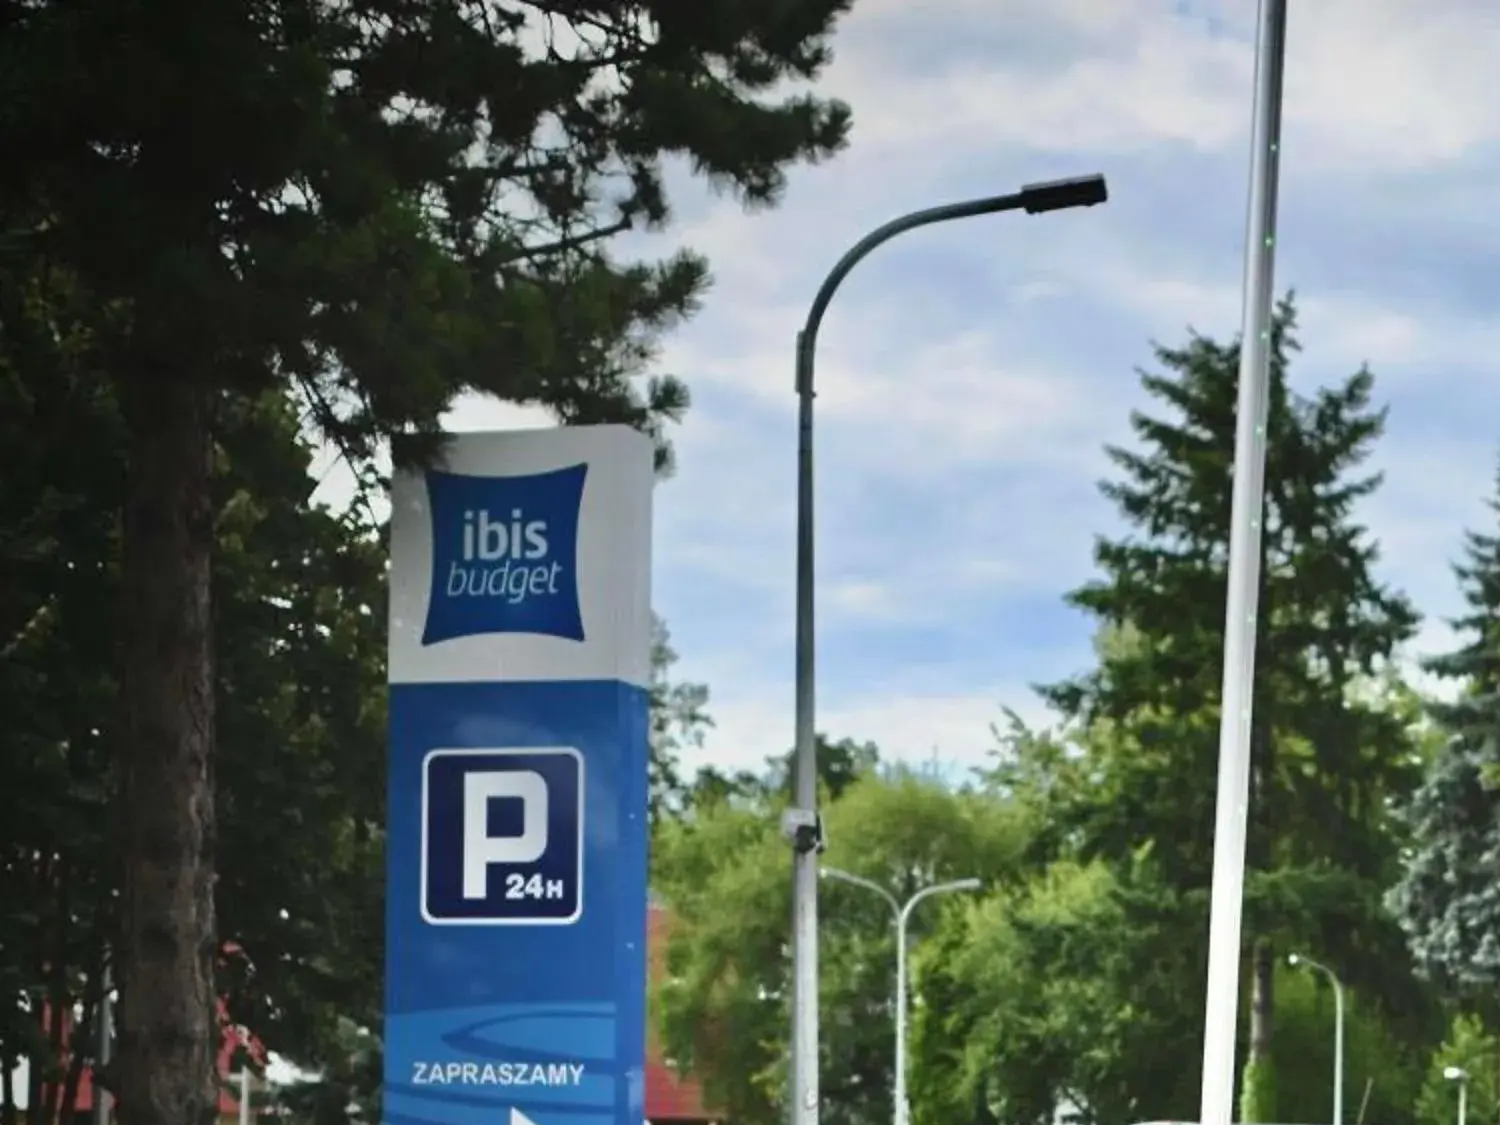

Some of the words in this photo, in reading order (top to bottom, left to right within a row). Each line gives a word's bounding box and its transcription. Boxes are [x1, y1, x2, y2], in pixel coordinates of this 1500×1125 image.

[463, 509, 548, 561] ibis
[447, 561, 563, 604] budget
[463, 770, 549, 899] P
[505, 873, 564, 899] 24H
[413, 1062, 585, 1086] ZAPRASZAMY
